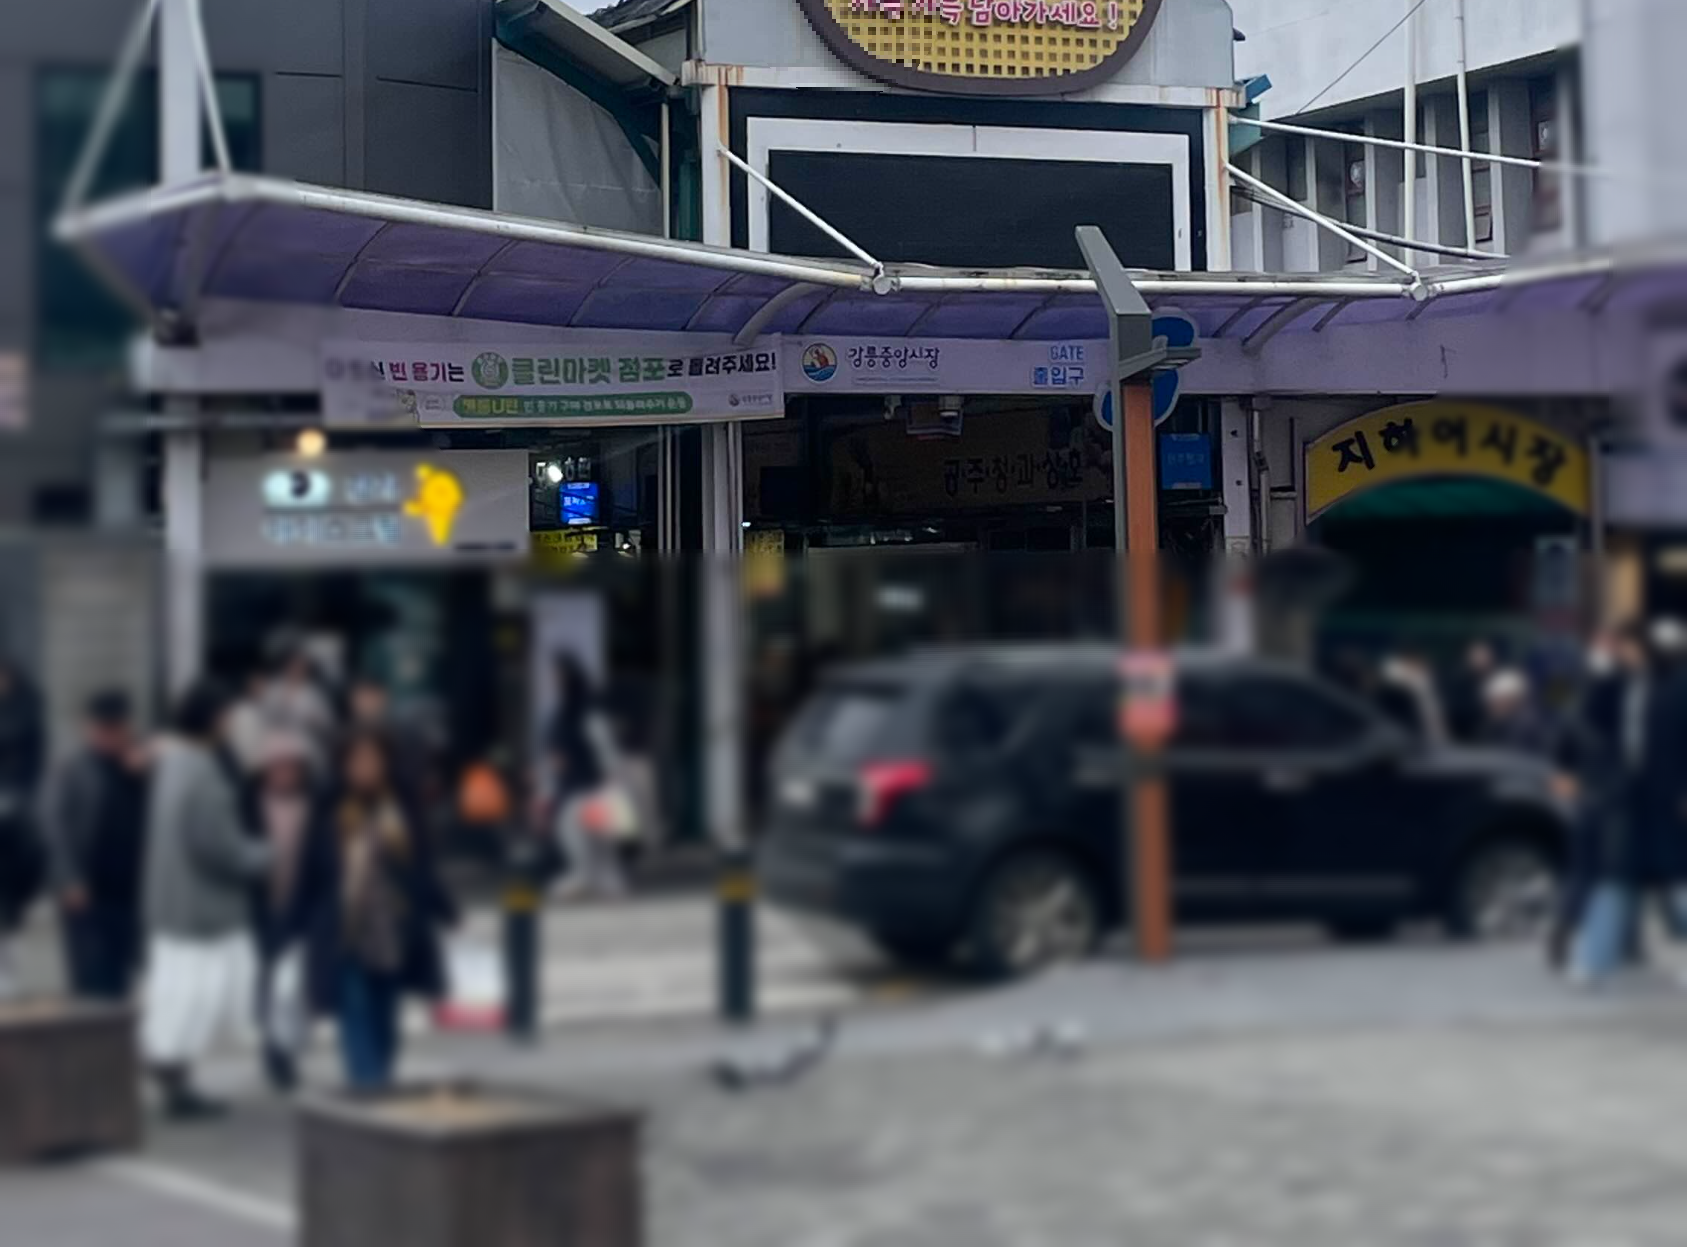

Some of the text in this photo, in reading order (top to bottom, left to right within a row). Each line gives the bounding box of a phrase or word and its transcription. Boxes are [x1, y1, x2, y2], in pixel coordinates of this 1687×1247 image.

[848, 345, 940, 369] 강릉중앙시장
[1050, 345, 1084, 360] GATE
[389, 361, 408, 381] 빈
[412, 361, 465, 382] 용기는
[511, 357, 612, 384] 클린마켓
[618, 356, 684, 383] 점포로
[1331, 415, 1568, 486] 지하어시장
